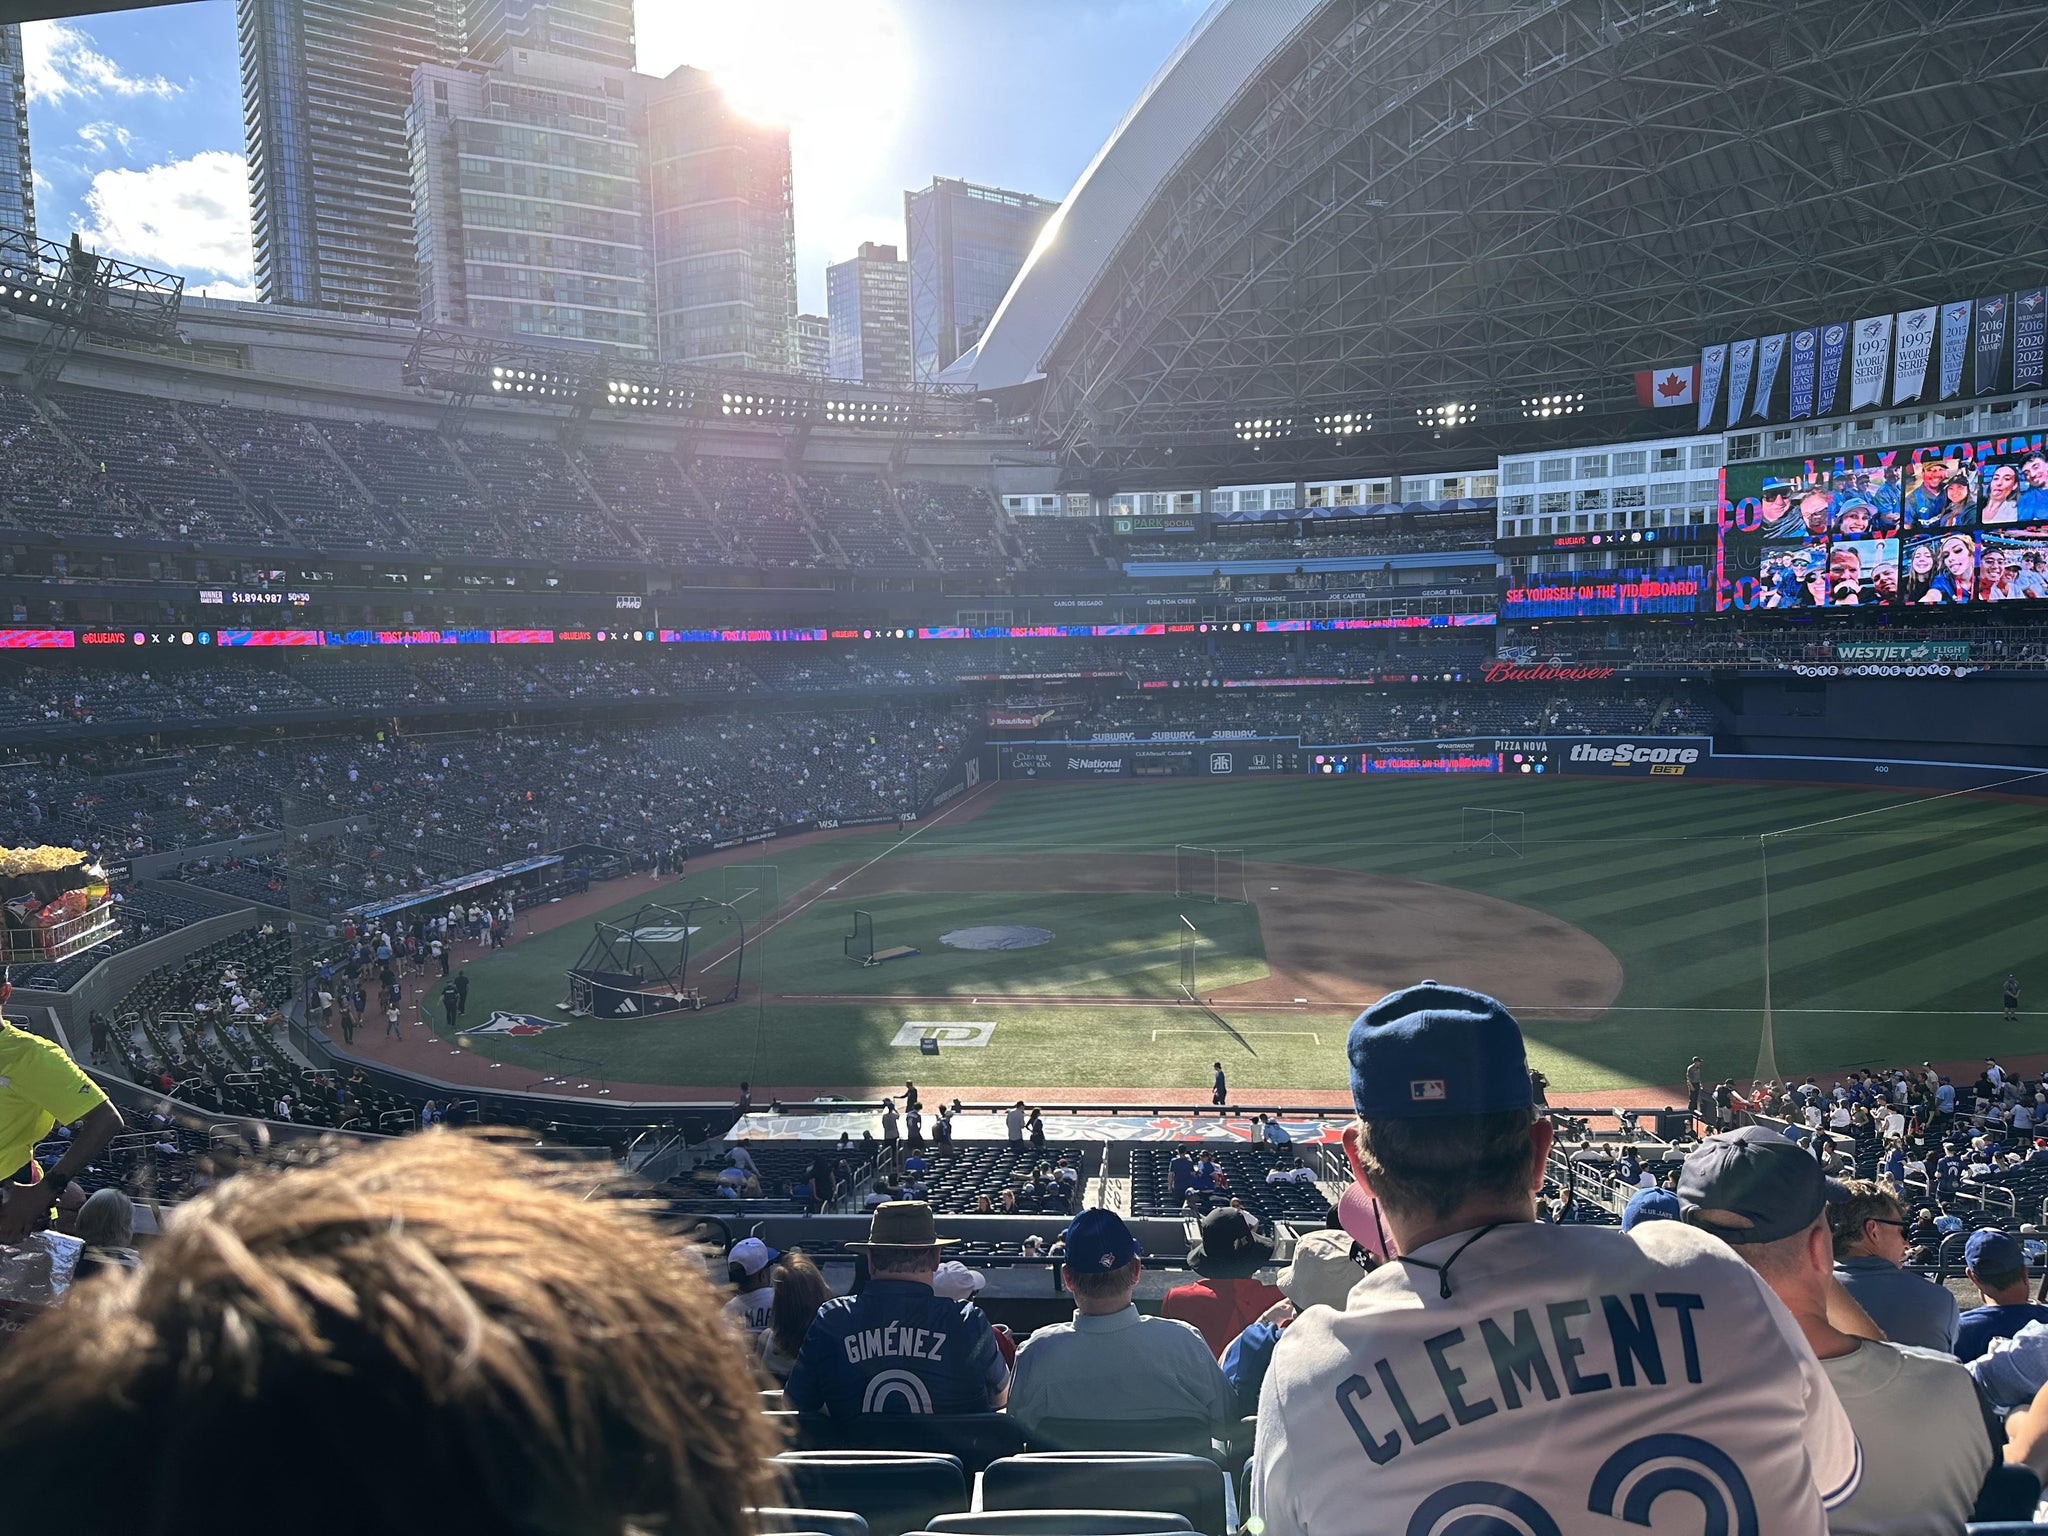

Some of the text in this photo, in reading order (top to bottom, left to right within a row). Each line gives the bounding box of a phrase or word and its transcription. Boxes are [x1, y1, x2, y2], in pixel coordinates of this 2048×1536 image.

[1946, 326, 1967, 338] 2015
[1979, 319, 2003, 333] 2016
[2018, 319, 2043, 333] 2016
[1901, 331, 1931, 349] 1993
[2017, 335, 2045, 348] 2020
[1857, 339, 1887, 356] 1992
[1944, 345, 1965, 354] LEAGU
[1978, 343, 2001, 352] CHAMP
[1795, 351, 1814, 363] 1992
[2017, 350, 2044, 364] 2022
[1823, 370, 1839, 381] EAS
[2016, 365, 2044, 378] 2023
[1793, 376, 1814, 385] EAST
[1134, 519, 1163, 528] PARK
[1164, 520, 1194, 528] SOCIAL
[1554, 537, 1586, 546] @BLUEJAYS
[200, 591, 224, 599] WINNER
[1506, 590, 1525, 603] SEE
[1527, 587, 1576, 601] YOURSELF
[1579, 586, 1594, 600] ON
[1596, 585, 1617, 599] THE
[616, 598, 642, 609] KPMG
[82, 632, 126, 644] @BLUEJAYS
[1838, 646, 1968, 661] WESTJET FLIGHT
[1480, 661, 1615, 683] Budweiser
[1798, 662, 1950, 677] VOTE BLUE JAYS
[1092, 733, 1135, 741] SUBWAY
[1151, 731, 1196, 740] SUBWAY
[1212, 730, 1257, 739] SUBWAY
[1495, 741, 1548, 752] PIZZA NOVA
[1569, 744, 1699, 763] theScore
[1079, 759, 1123, 769] National
[1375, 759, 1387, 768] SEE
[1388, 759, 1421, 768] YOURSELF
[1422, 759, 1432, 768] ON
[1433, 759, 1445, 768] THE
[1874, 765, 1889, 773] 400
[1653, 766, 1677, 774] BET
[819, 820, 839, 829] VISA
[1639, 1207, 1673, 1219] BLUE JAYS
[844, 1320, 947, 1364] GIMÉNEZ
[1336, 1292, 1705, 1465] CLEMENT
